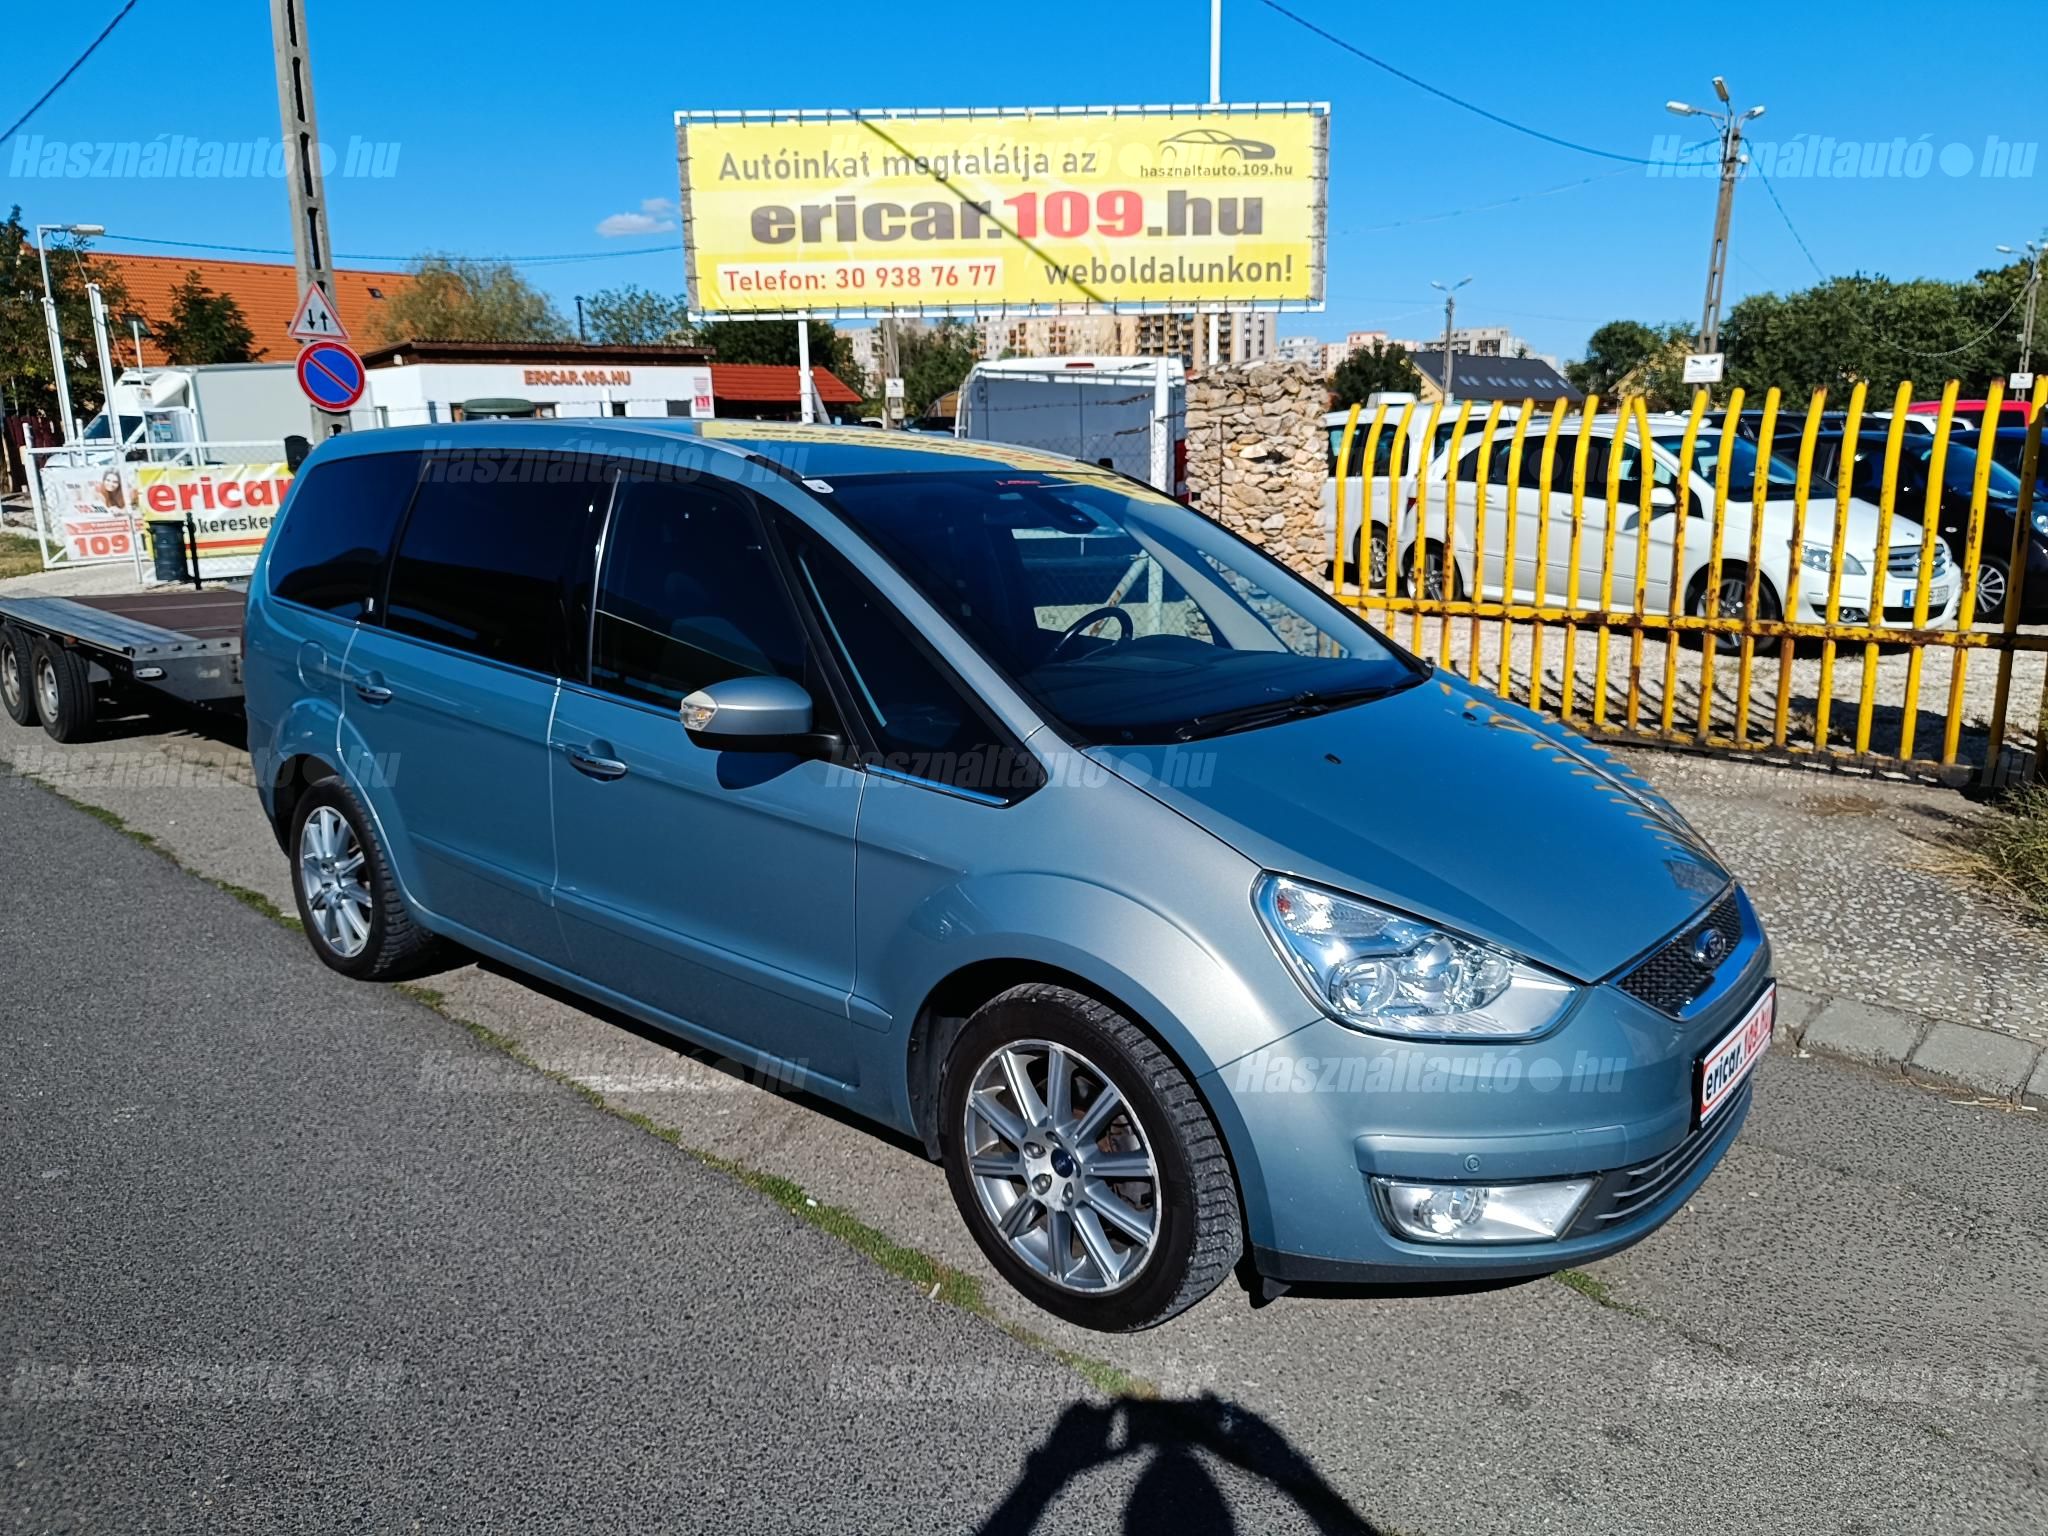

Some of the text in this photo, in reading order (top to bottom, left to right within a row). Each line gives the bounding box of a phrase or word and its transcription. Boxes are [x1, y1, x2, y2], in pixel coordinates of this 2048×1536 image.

[719, 145, 1097, 183] Autóinkat megtalálja az
[750, 190, 1263, 245] ericar.109.hu
[724, 265, 996, 291] Telefon: 30 938 76 77
[1045, 254, 1292, 284] weboldalunkon!
